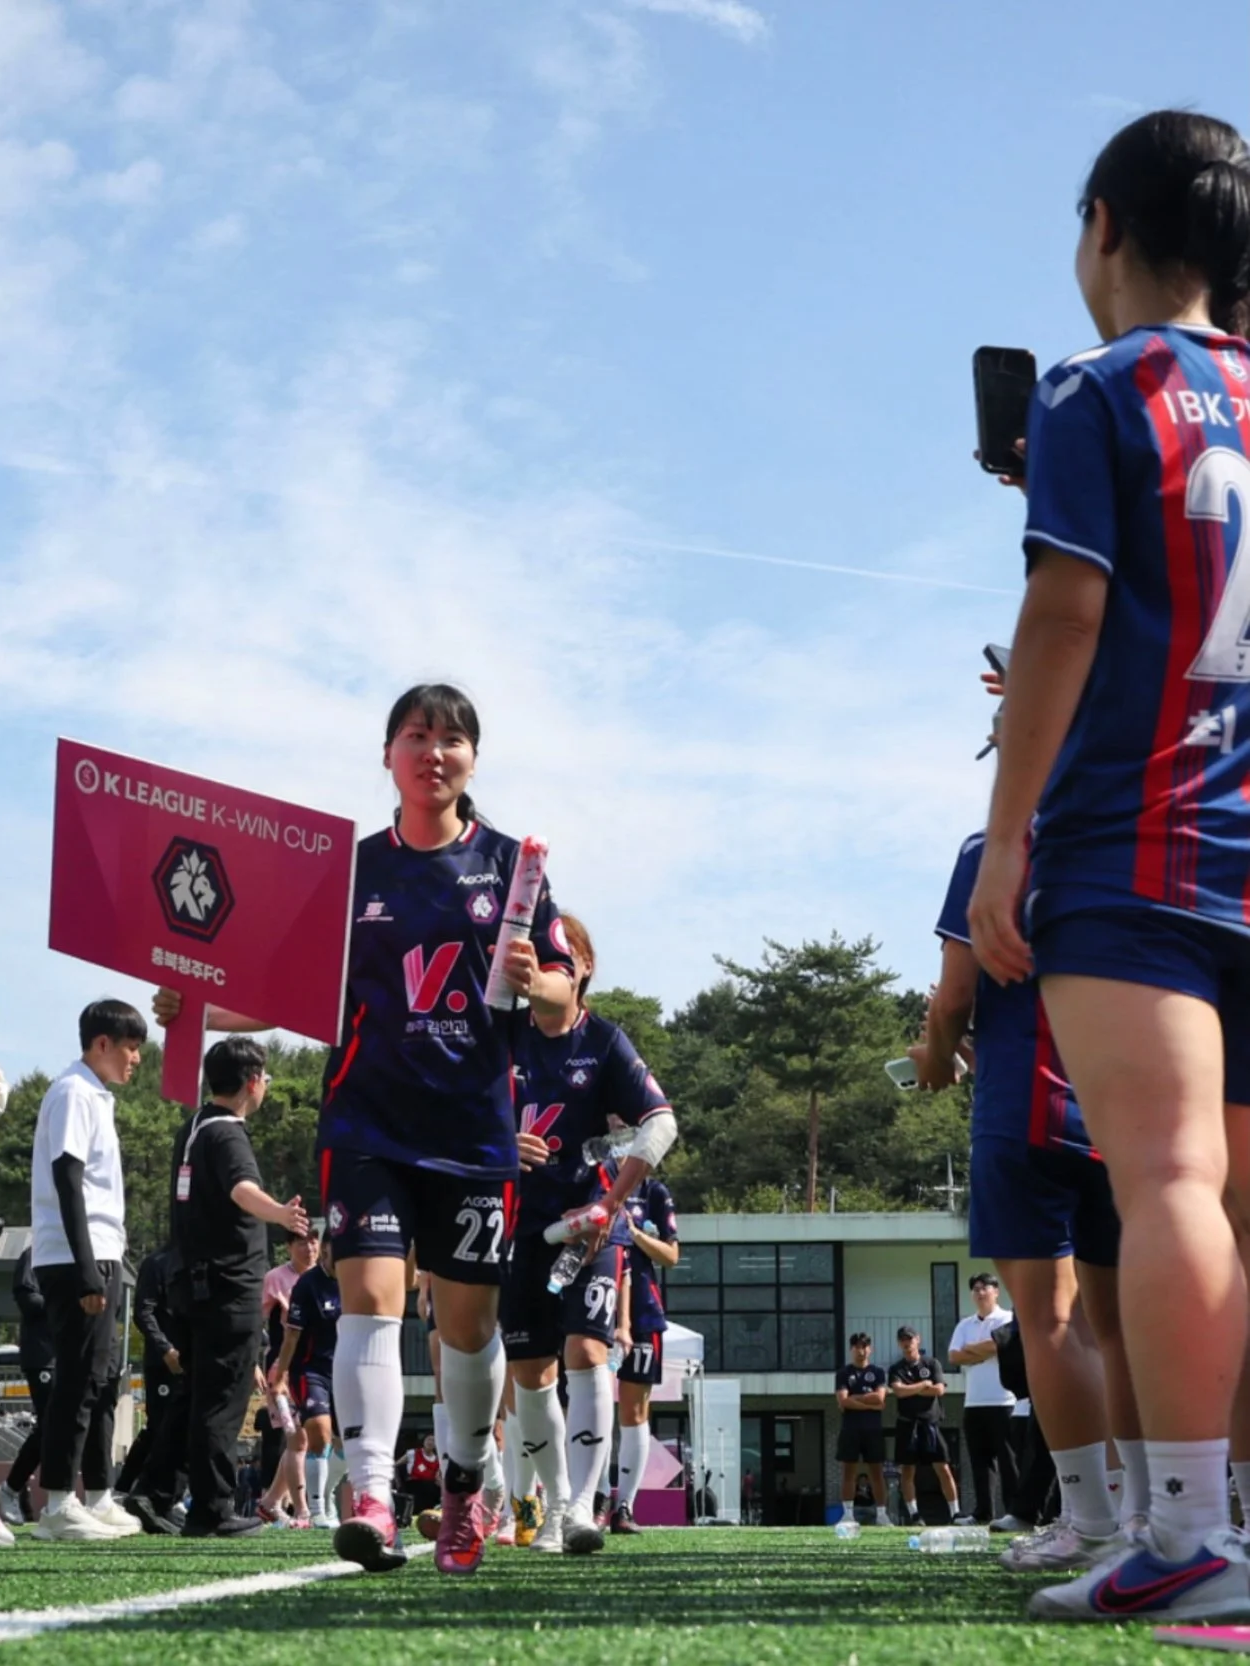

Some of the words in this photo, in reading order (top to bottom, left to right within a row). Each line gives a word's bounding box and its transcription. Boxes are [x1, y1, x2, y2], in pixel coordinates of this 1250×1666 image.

[104, 771, 121, 797] K
[124, 777, 207, 822] LEAGUE
[212, 803, 279, 843] K-WIN
[284, 825, 332, 856] CUP
[457, 874, 503, 886] AGORA
[151, 946, 226, 986] 충북청주FC
[452, 1207, 506, 1264] 22
[584, 1283, 617, 1326] 99
[633, 1346, 654, 1374] 17
